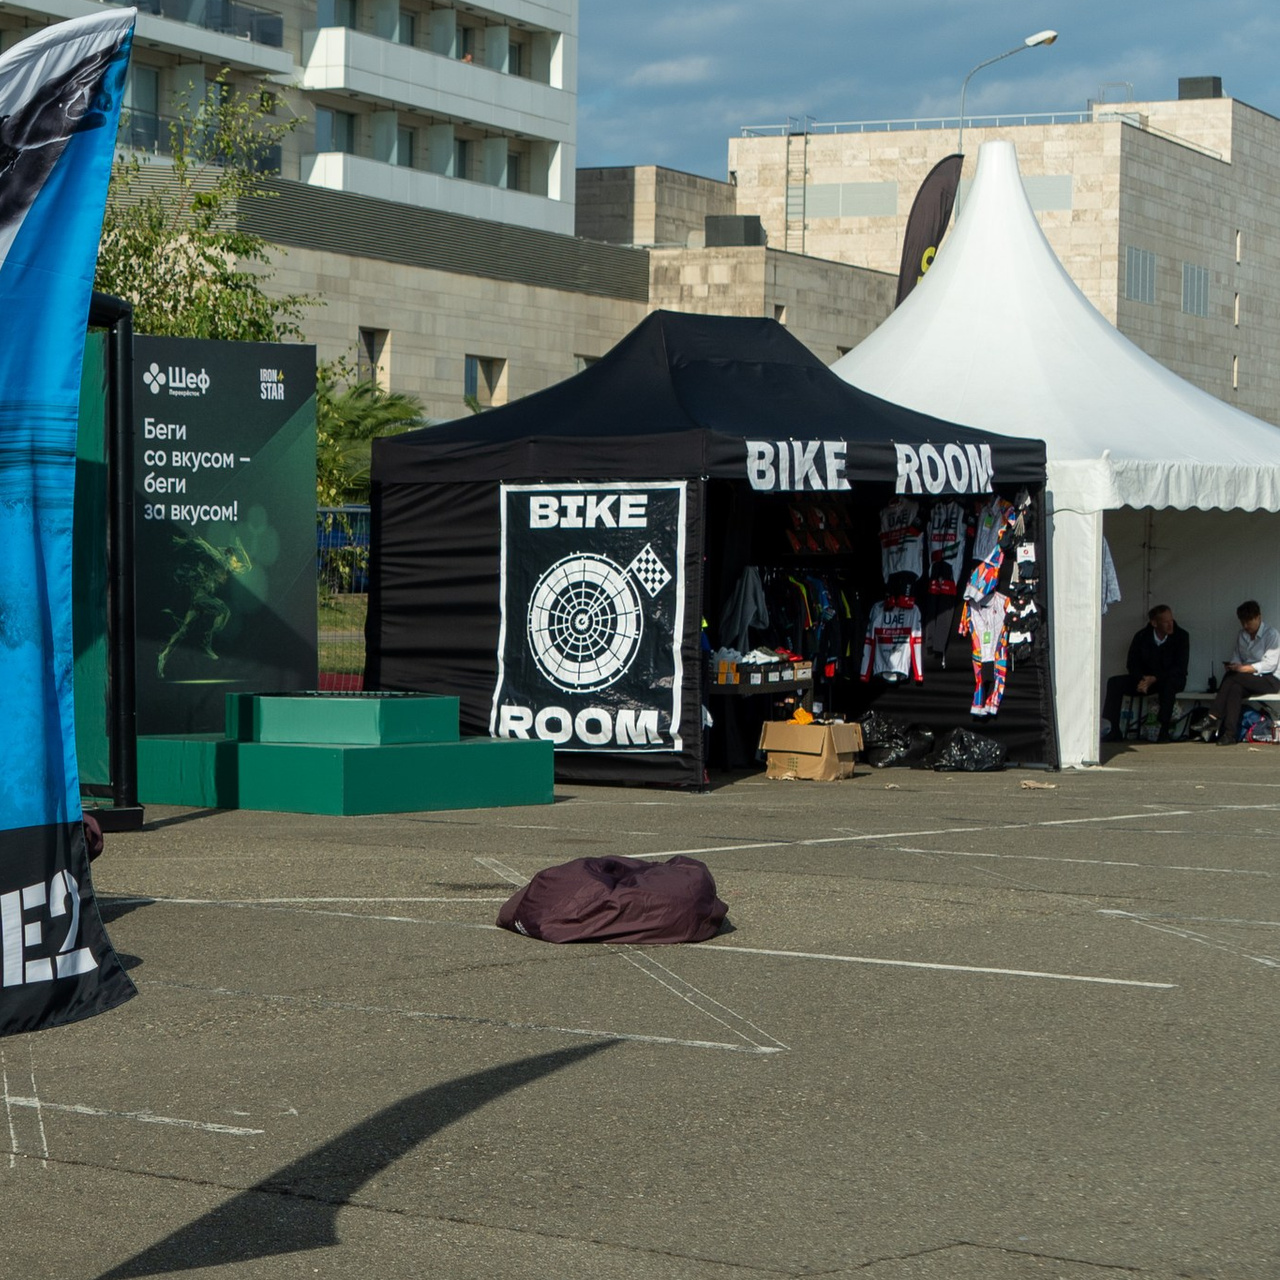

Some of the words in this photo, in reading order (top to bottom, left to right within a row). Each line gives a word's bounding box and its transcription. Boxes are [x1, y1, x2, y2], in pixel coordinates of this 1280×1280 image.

[168, 366, 210, 394] Шеф
[260, 369, 278, 382] IRON
[260, 383, 285, 400] STAR
[144, 417, 187, 440] Беги
[144, 449, 167, 467] со
[172, 450, 234, 472] вкусом
[745, 440, 852, 490] BIKE
[894, 443, 994, 494] ROOM
[144, 472, 186, 494] беги
[144, 503, 166, 520] за
[171, 500, 238, 526] вкусом!
[529, 494, 648, 529] BIKE
[883, 613, 905, 625] UAE
[499, 705, 664, 745] ROOM
